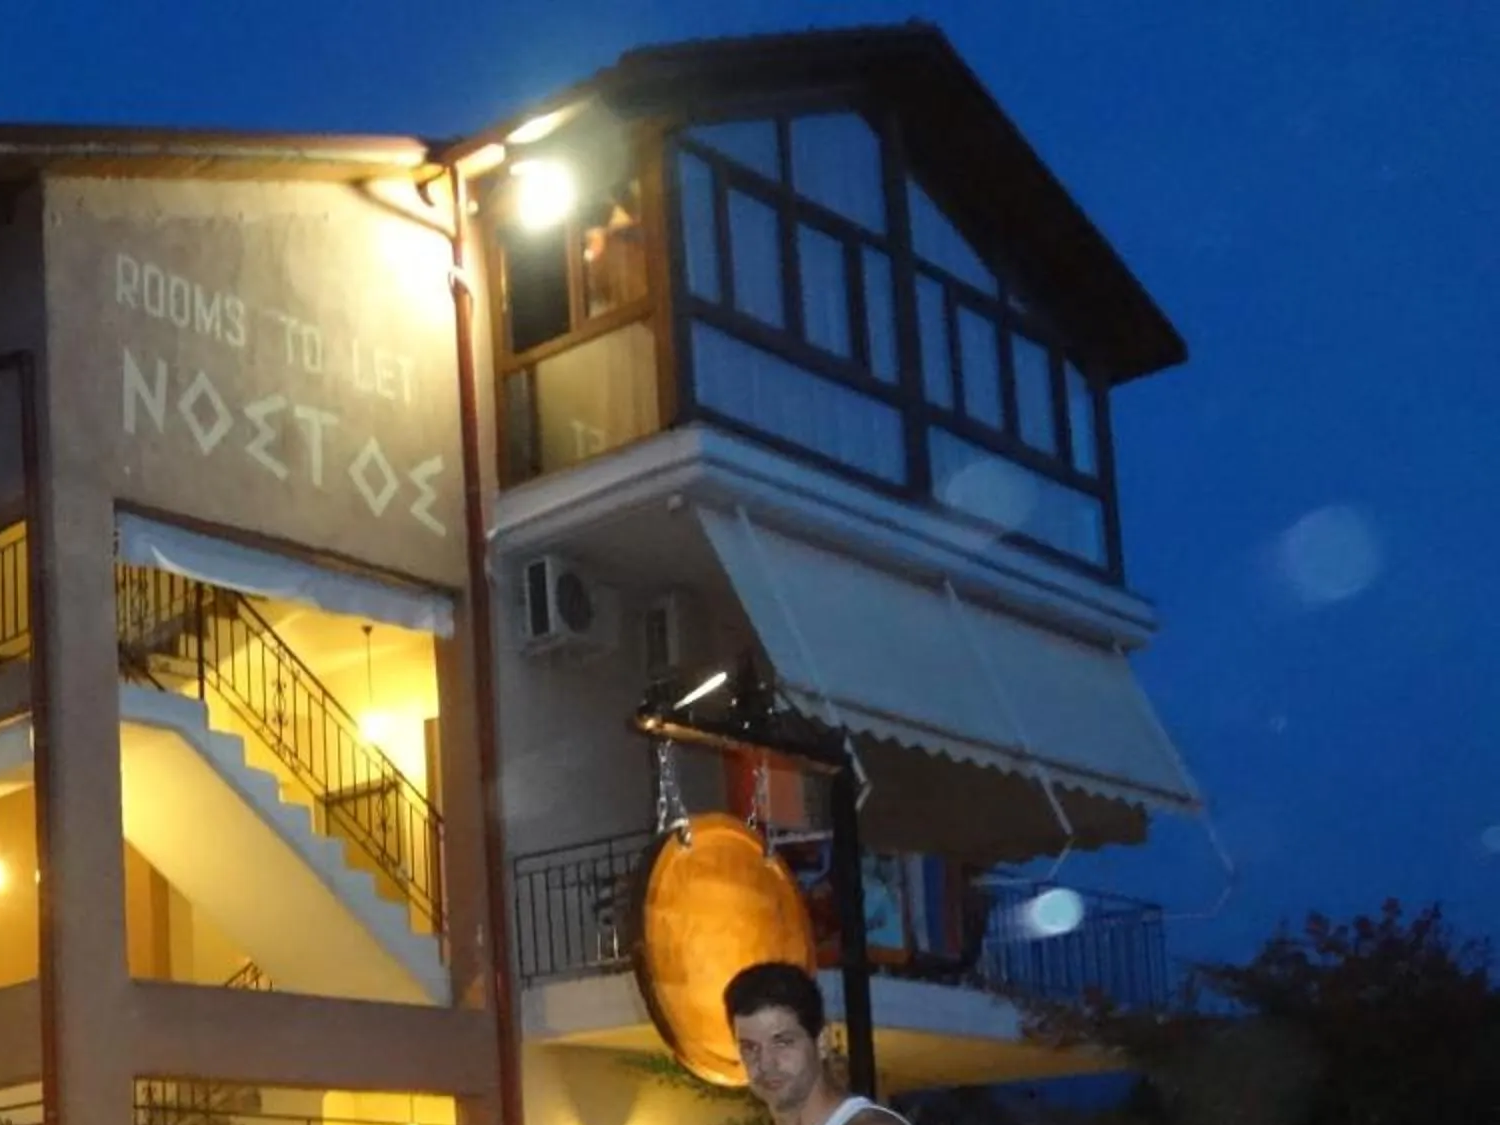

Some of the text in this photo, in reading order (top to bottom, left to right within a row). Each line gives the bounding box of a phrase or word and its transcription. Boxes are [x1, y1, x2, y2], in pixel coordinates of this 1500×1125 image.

[115, 253, 417, 405] ROOMS TO LET
